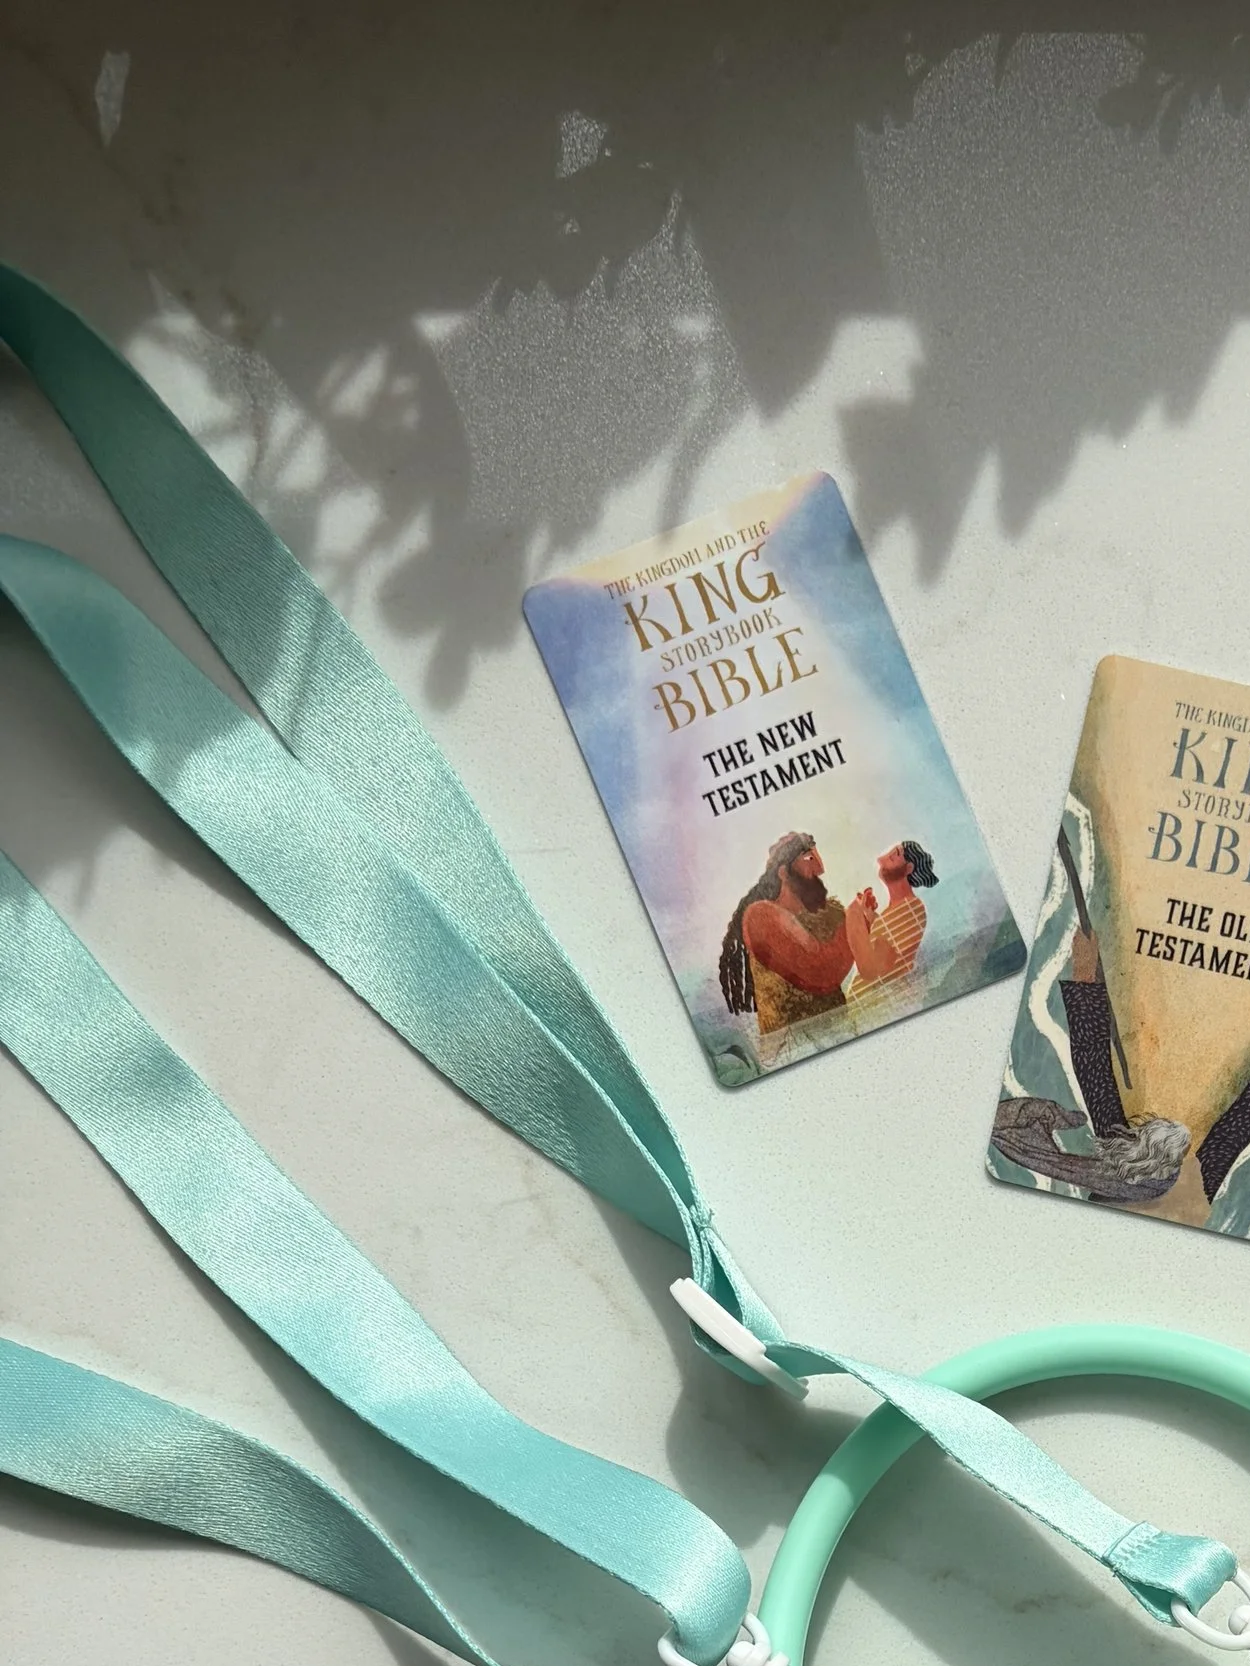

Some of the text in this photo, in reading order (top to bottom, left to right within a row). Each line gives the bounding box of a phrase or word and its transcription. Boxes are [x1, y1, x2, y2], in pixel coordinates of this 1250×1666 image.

[604, 520, 770, 599] THE KINGDOM AND THE
[623, 541, 786, 652] KING
[660, 607, 782, 672] STORYBOOK
[652, 628, 819, 733] BIBLE
[1175, 702, 1203, 723] THE
[702, 739, 847, 818] TESTAMENT
[703, 711, 818, 778] THE NEW
[1166, 898, 1213, 933] THE
